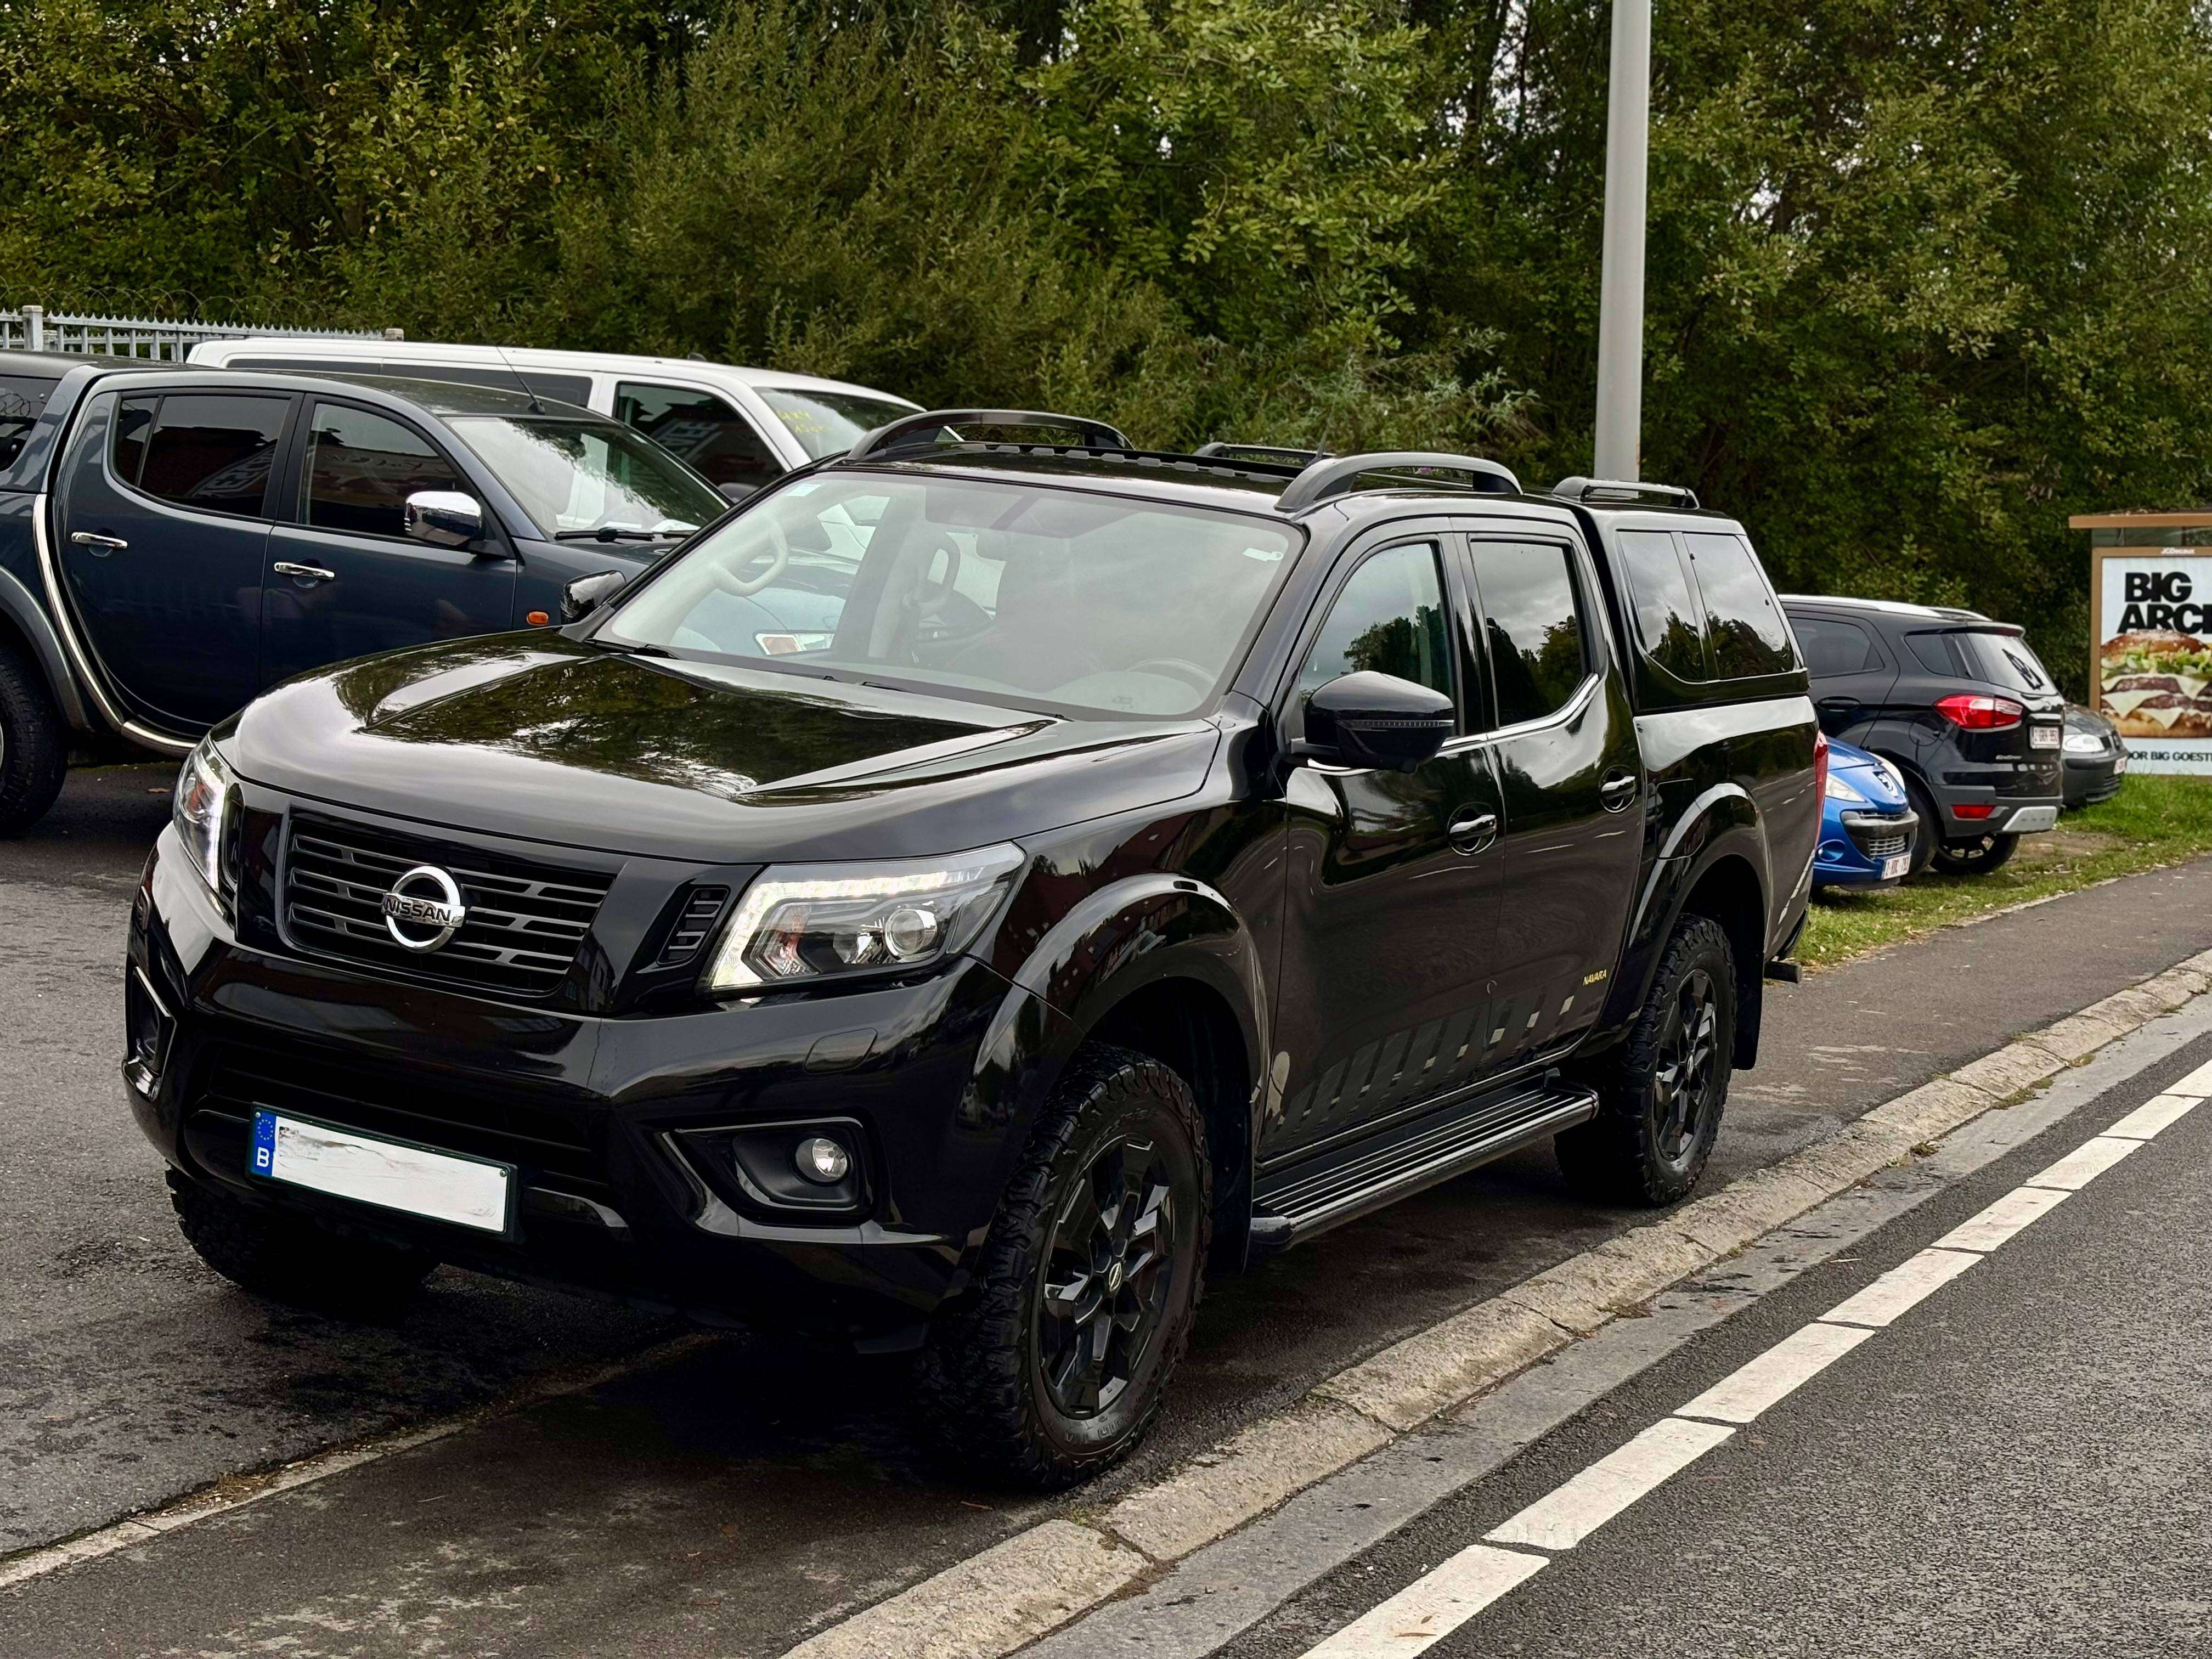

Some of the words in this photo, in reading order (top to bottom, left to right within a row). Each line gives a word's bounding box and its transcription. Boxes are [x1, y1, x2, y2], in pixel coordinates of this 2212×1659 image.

[2125, 572, 2192, 603] BIG
[2151, 751, 2170, 761] BIG
[386, 898, 452, 922] NISSAN
[1583, 969, 1607, 986] NAVARA
[256, 1147, 269, 1168] B
